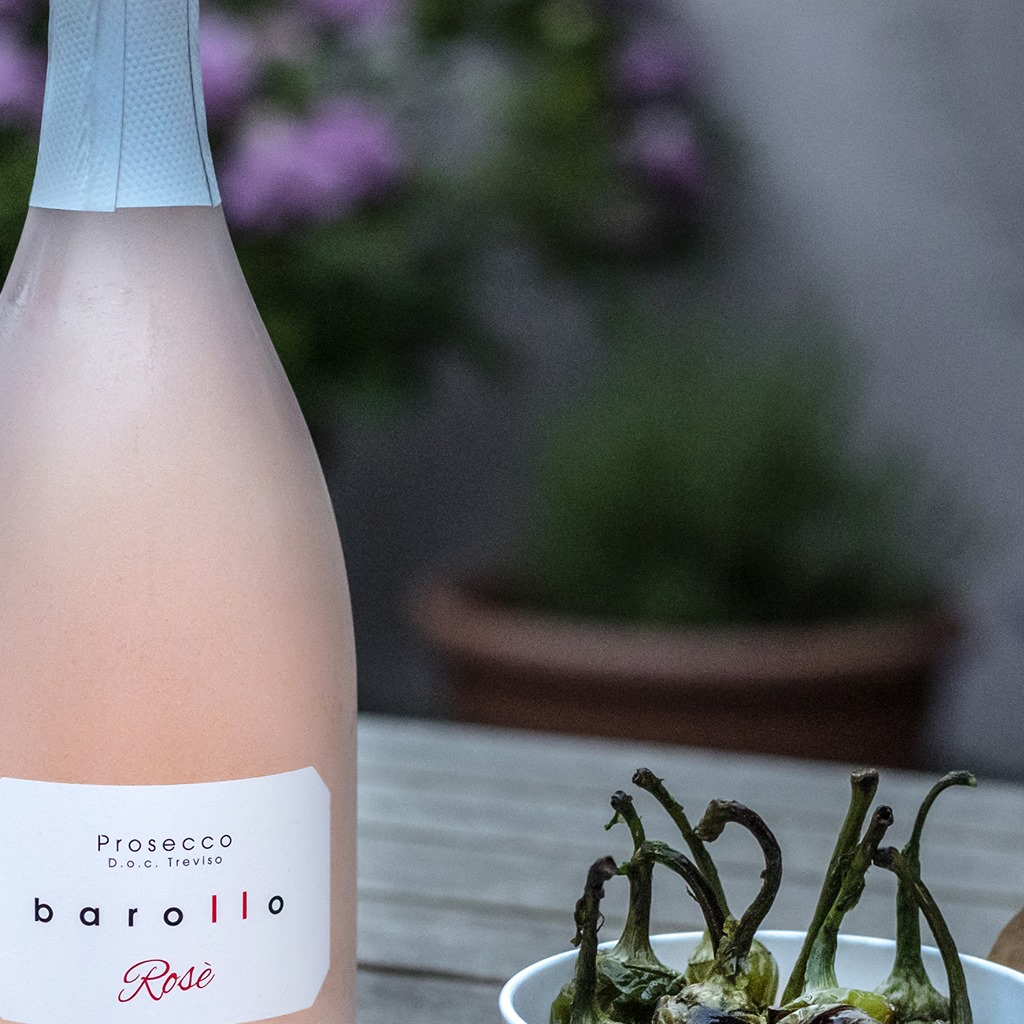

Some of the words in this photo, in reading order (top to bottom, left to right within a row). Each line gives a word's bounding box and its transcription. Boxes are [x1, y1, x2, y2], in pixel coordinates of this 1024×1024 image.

[97, 834, 233, 853] Prosecco
[108, 857, 159, 869] D.o.c.
[167, 855, 223, 868] Treviso
[33, 891, 285, 927] barollo
[118, 958, 216, 1003] Rosè
